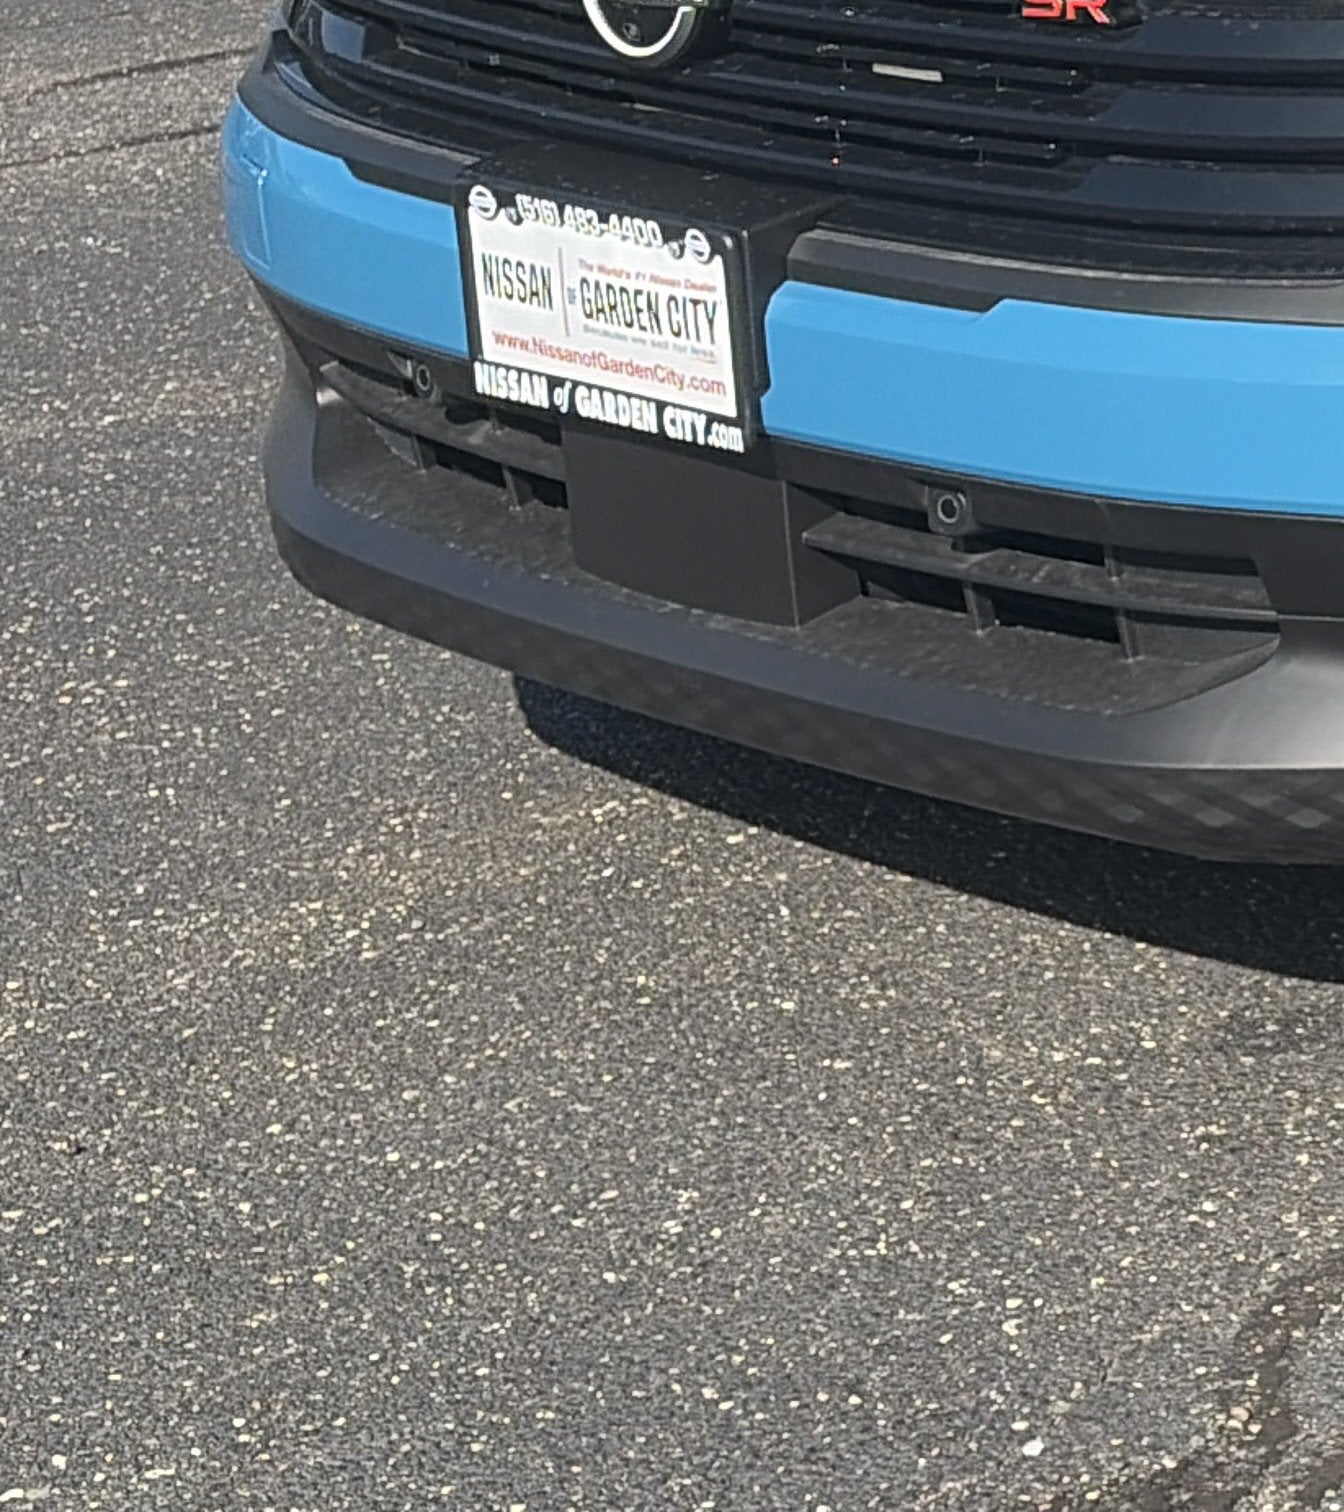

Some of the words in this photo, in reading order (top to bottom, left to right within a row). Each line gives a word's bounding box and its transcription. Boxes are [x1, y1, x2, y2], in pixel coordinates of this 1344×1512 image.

[515, 193, 560, 227] (516)
[563, 204, 663, 247] 483-4400
[482, 252, 554, 311] NISSAN
[580, 276, 662, 336] GARDEN
[667, 293, 718, 345] CITY
[473, 361, 550, 410] NISSAN
[553, 380, 573, 414] of
[574, 385, 659, 434] GARDEN
[492, 329, 727, 396] www.NissanofGardenCity.com
